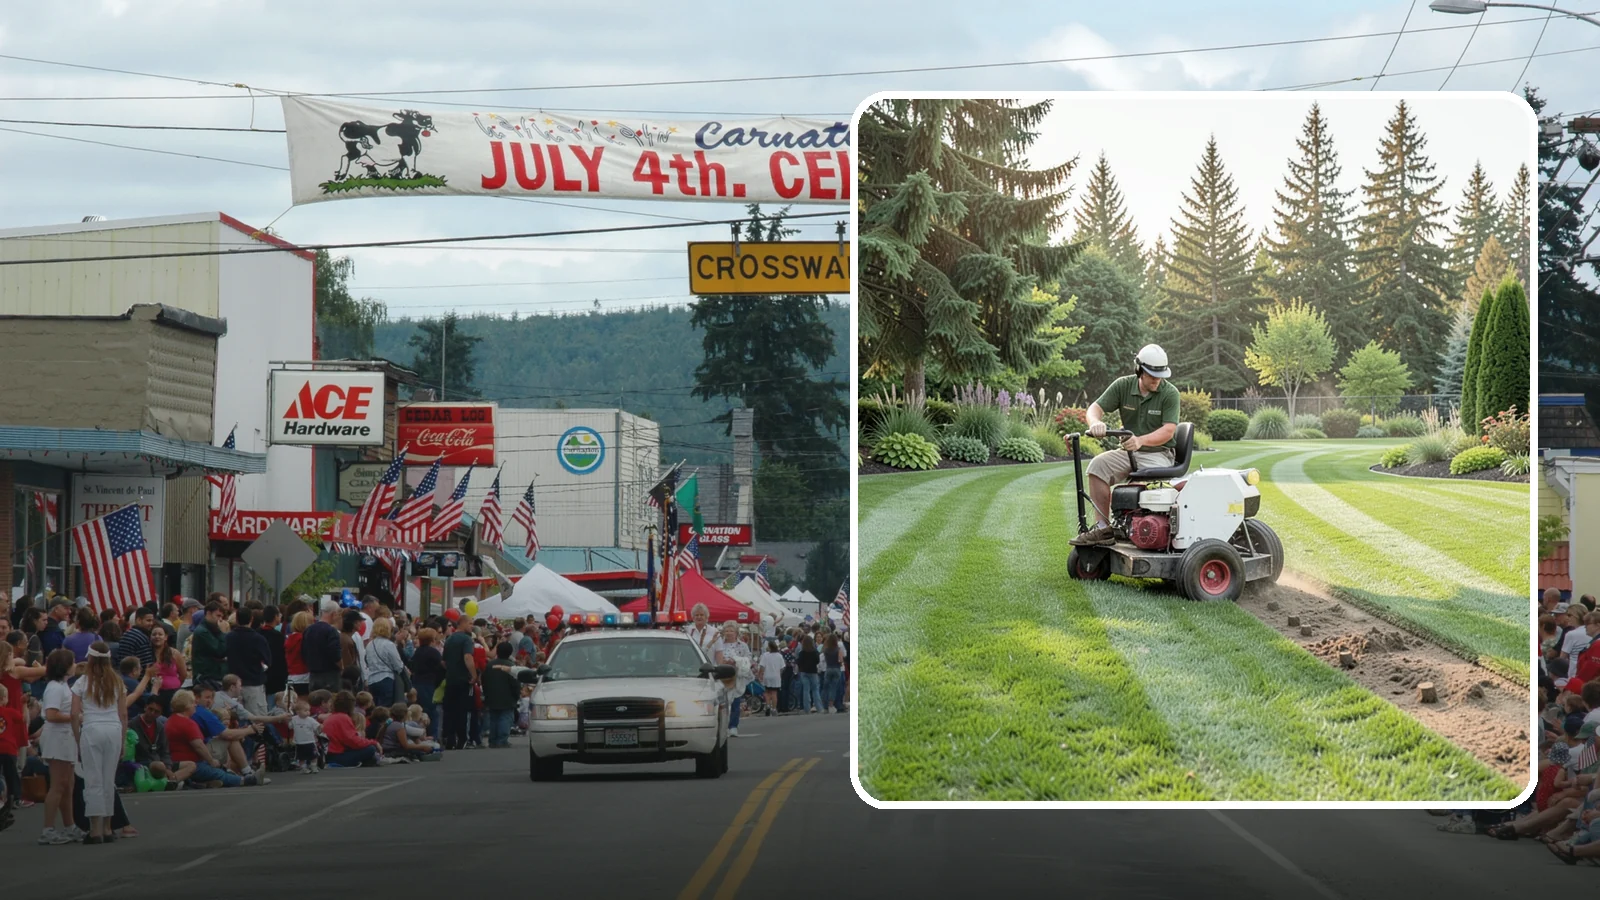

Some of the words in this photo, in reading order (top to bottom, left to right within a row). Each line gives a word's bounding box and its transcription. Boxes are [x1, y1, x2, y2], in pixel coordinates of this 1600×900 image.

[694, 121, 850, 150] Carnat
[481, 141, 604, 192] JULY
[632, 150, 746, 198] 4th.
[696, 254, 850, 280] CROSSWA
[283, 380, 373, 420] ACE
[405, 409, 452, 422] CEDAR
[461, 409, 485, 421] LOG
[283, 421, 371, 437] Hardware
[95, 485, 124, 495] Vincent
[126, 486, 136, 495] de
[137, 486, 155, 495] Paul
[81, 503, 154, 522] THT
[688, 526, 741, 535] CRNATION
[700, 535, 730, 544] GLASS
